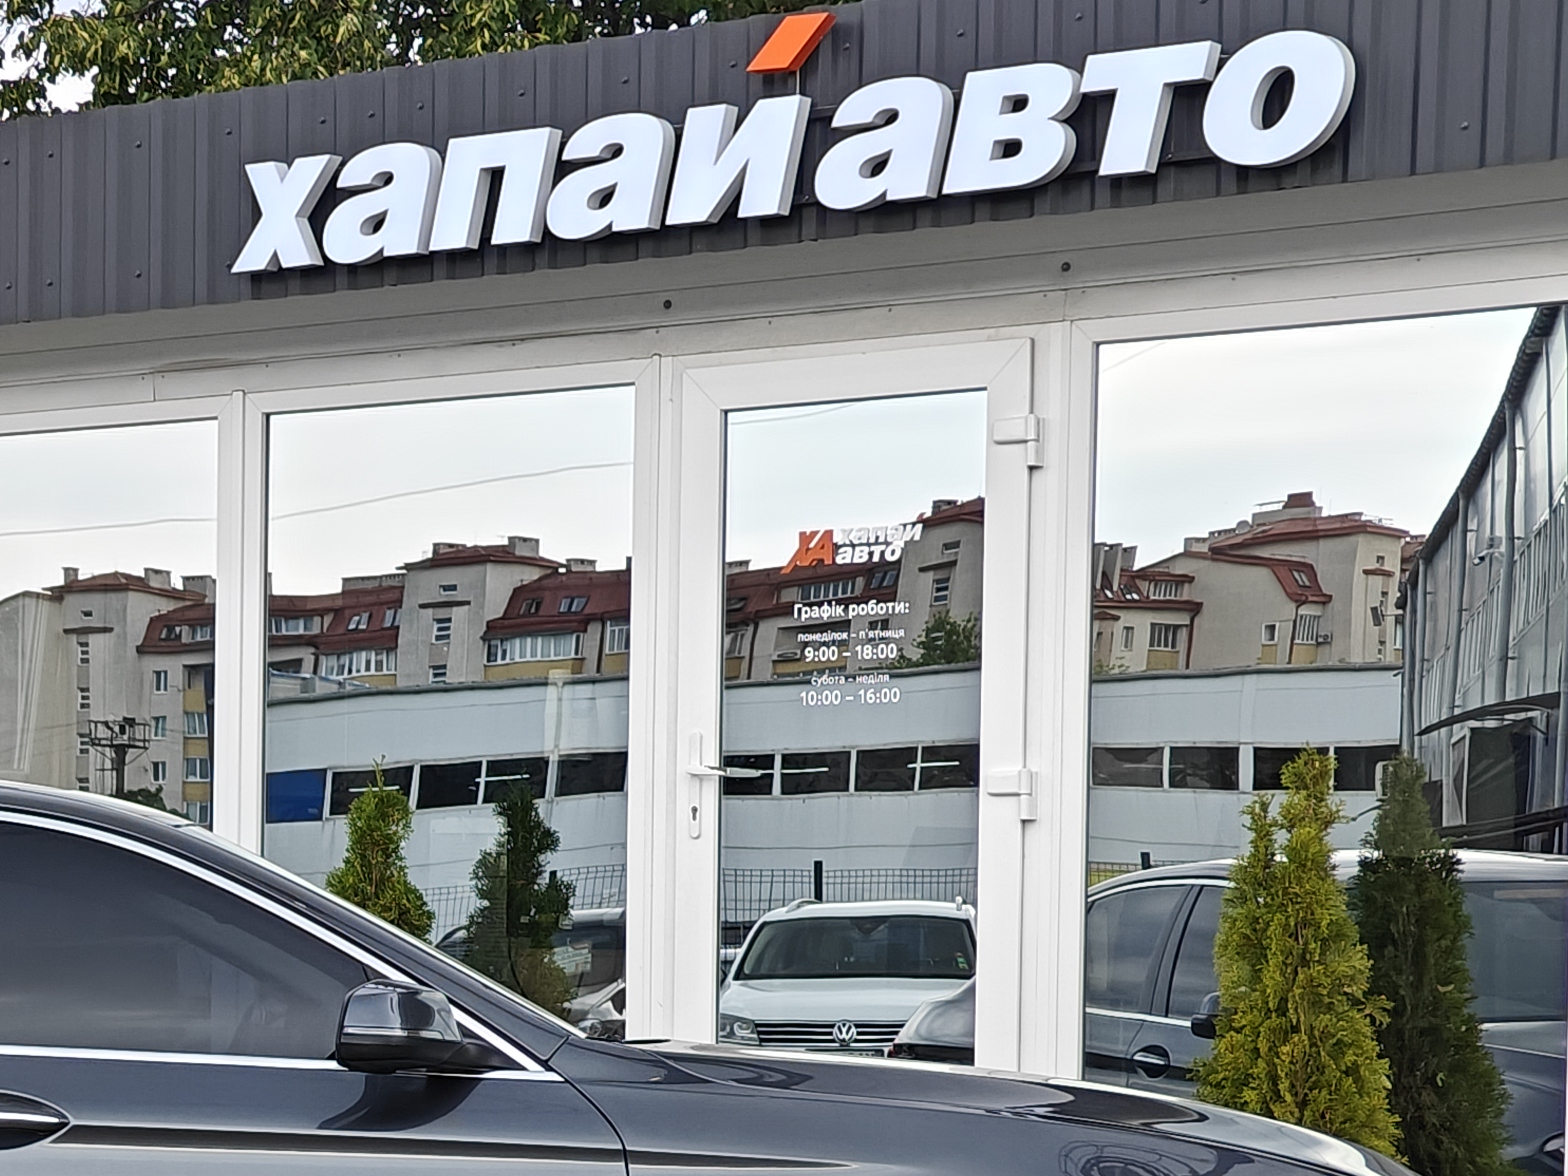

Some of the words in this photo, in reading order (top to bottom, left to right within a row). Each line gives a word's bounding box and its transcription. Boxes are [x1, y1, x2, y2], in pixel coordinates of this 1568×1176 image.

[231, 12, 837, 275] хапай
[813, 30, 1355, 210] авто
[835, 543, 903, 565] авто
[793, 601, 845, 622] Графік
[848, 599, 910, 618] роботи:
[797, 631, 849, 642] понеділок
[804, 646, 838, 662] 9:00
[855, 644, 898, 660] 18:00
[811, 674, 845, 686] субота
[856, 673, 889, 684] неділя
[800, 690, 841, 706] 10:00
[858, 688, 901, 704] 16:00
